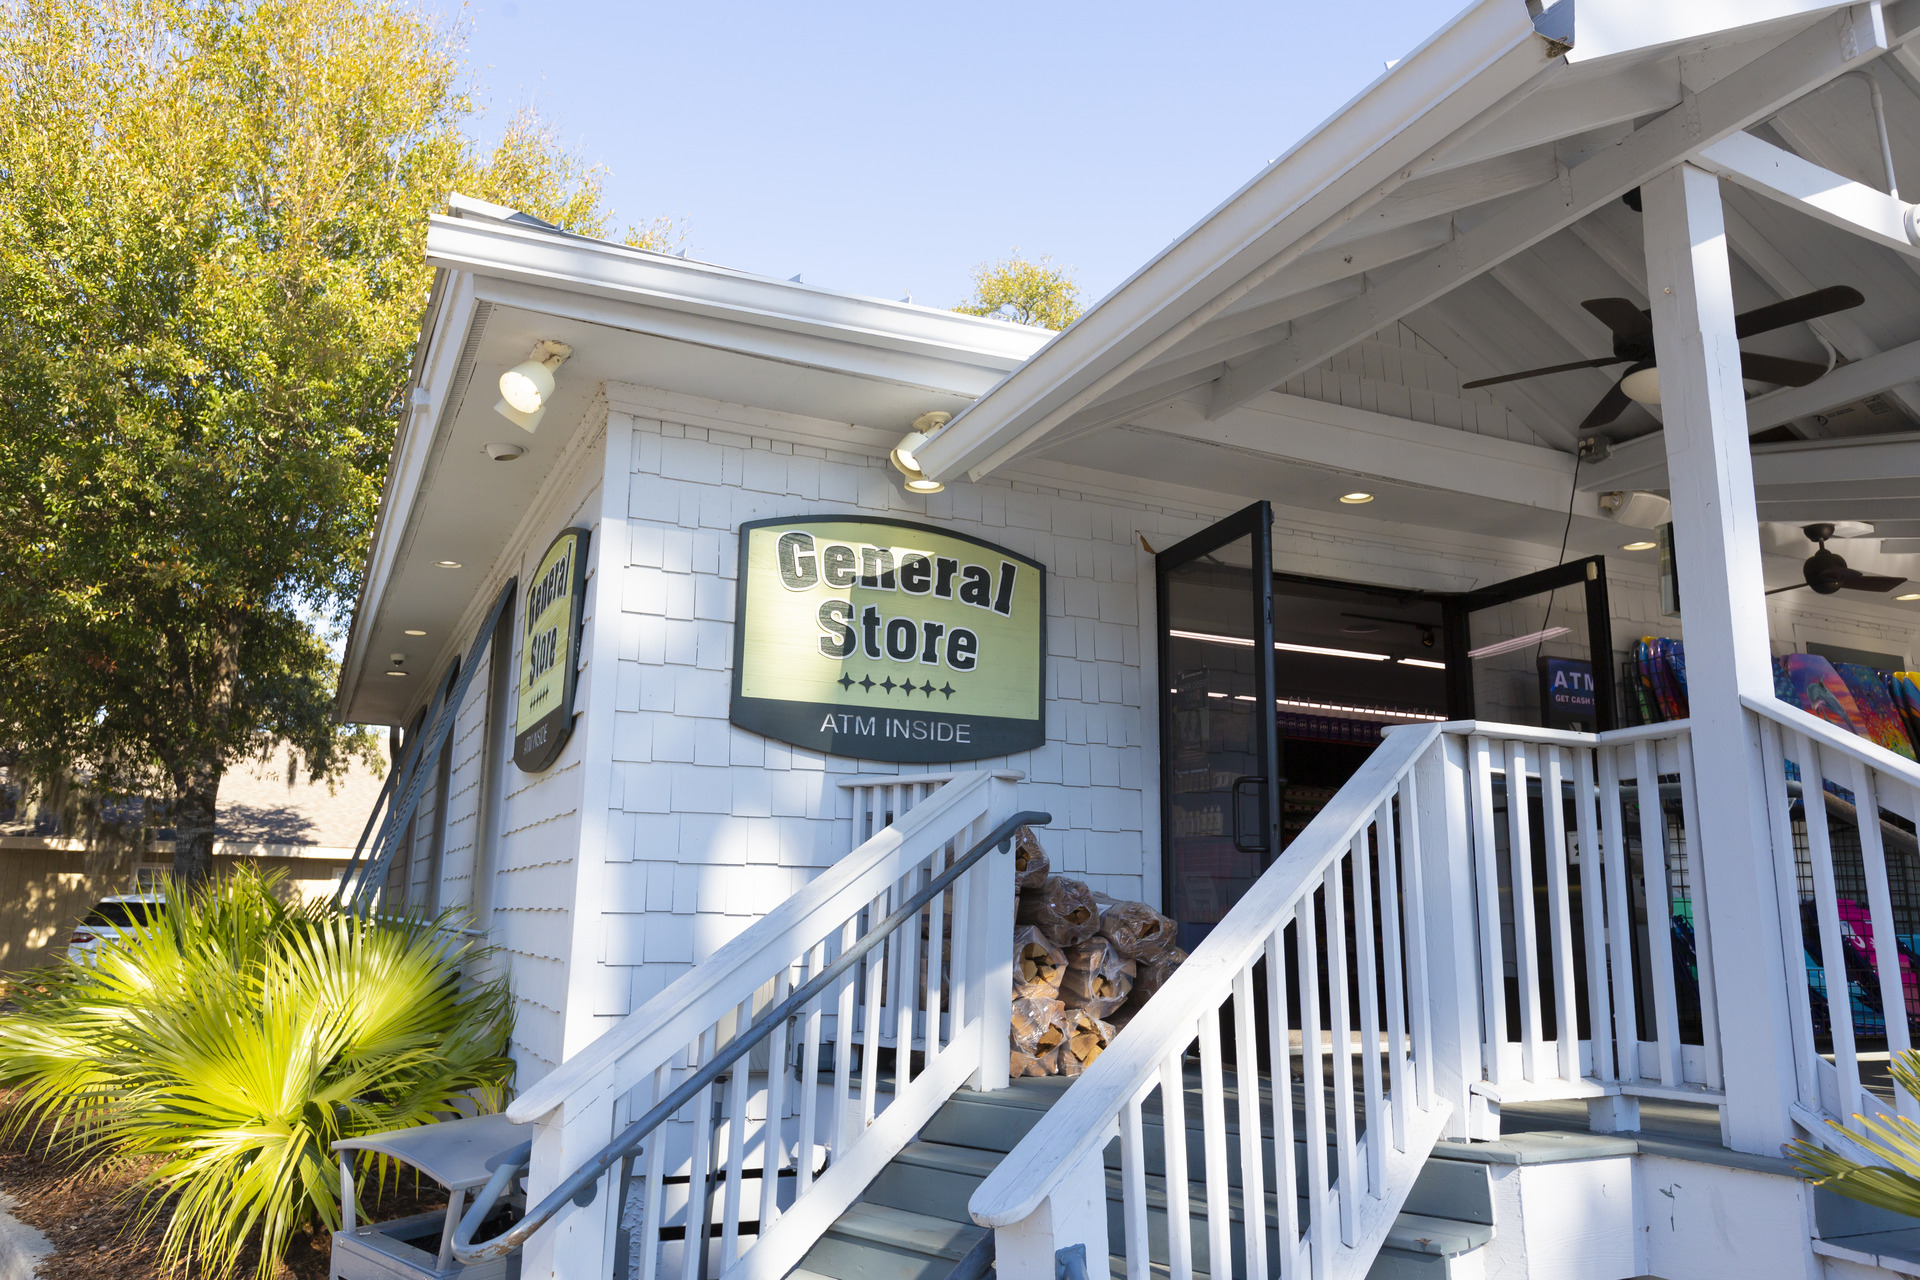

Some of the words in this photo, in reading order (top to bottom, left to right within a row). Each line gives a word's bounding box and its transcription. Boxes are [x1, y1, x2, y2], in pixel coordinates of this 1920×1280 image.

[528, 540, 573, 637] General
[777, 530, 1018, 618] General
[529, 625, 558, 688] Store
[816, 600, 979, 672] Store
[820, 713, 875, 737] ATM
[886, 718, 971, 744] INSIDE
[1555, 694, 1569, 703] GET
[1571, 695, 1591, 705] CASH
